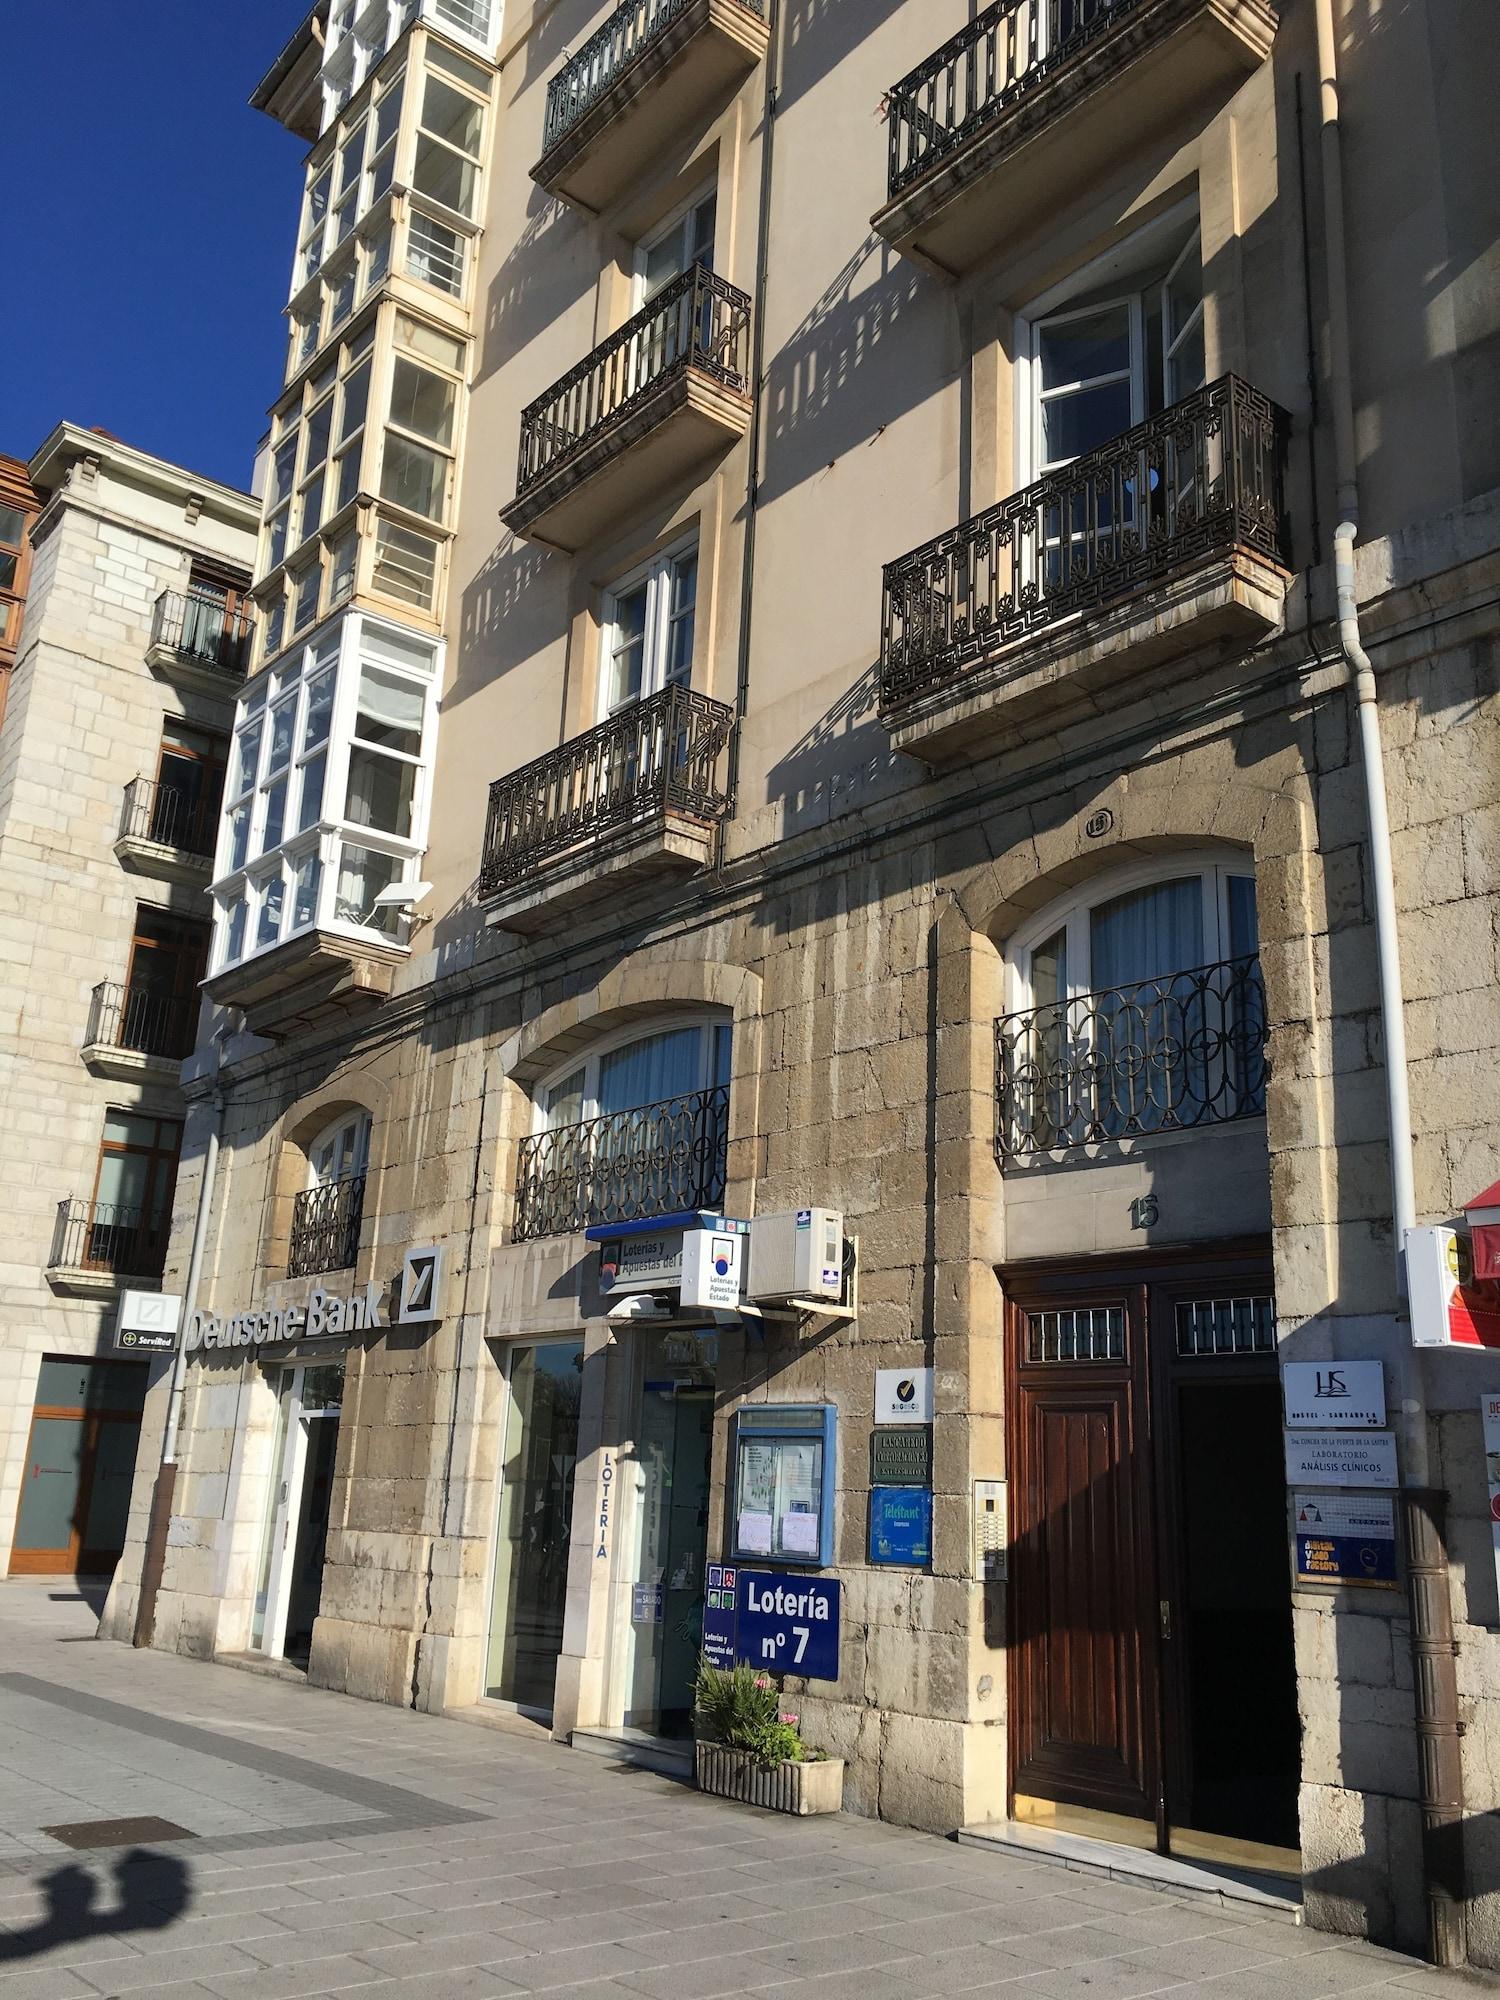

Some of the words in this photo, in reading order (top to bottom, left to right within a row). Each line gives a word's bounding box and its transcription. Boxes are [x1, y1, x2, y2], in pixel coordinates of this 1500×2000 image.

[1128, 1194, 1159, 1230] 15
[659, 1241, 665, 1256] y
[622, 1257, 661, 1276] Apuestas
[663, 1253, 677, 1268] del
[709, 1284, 737, 1294] Apuestas
[709, 1292, 730, 1302] Estado
[187, 1298, 301, 1351] Deutsche
[305, 1280, 386, 1336] Bank
[1311, 1450, 1369, 1460] LABORATORIO
[1300, 1461, 1339, 1472] ANÁLISIS
[1341, 1462, 1382, 1473] CLÍNICOS
[596, 1453, 613, 1559] LOTERIA
[748, 1581, 829, 1621] Lotería
[723, 1635, 728, 1645] y
[792, 1626, 810, 1664] 7
[704, 1643, 726, 1655] Apuestas
[725, 1646, 734, 1656] del
